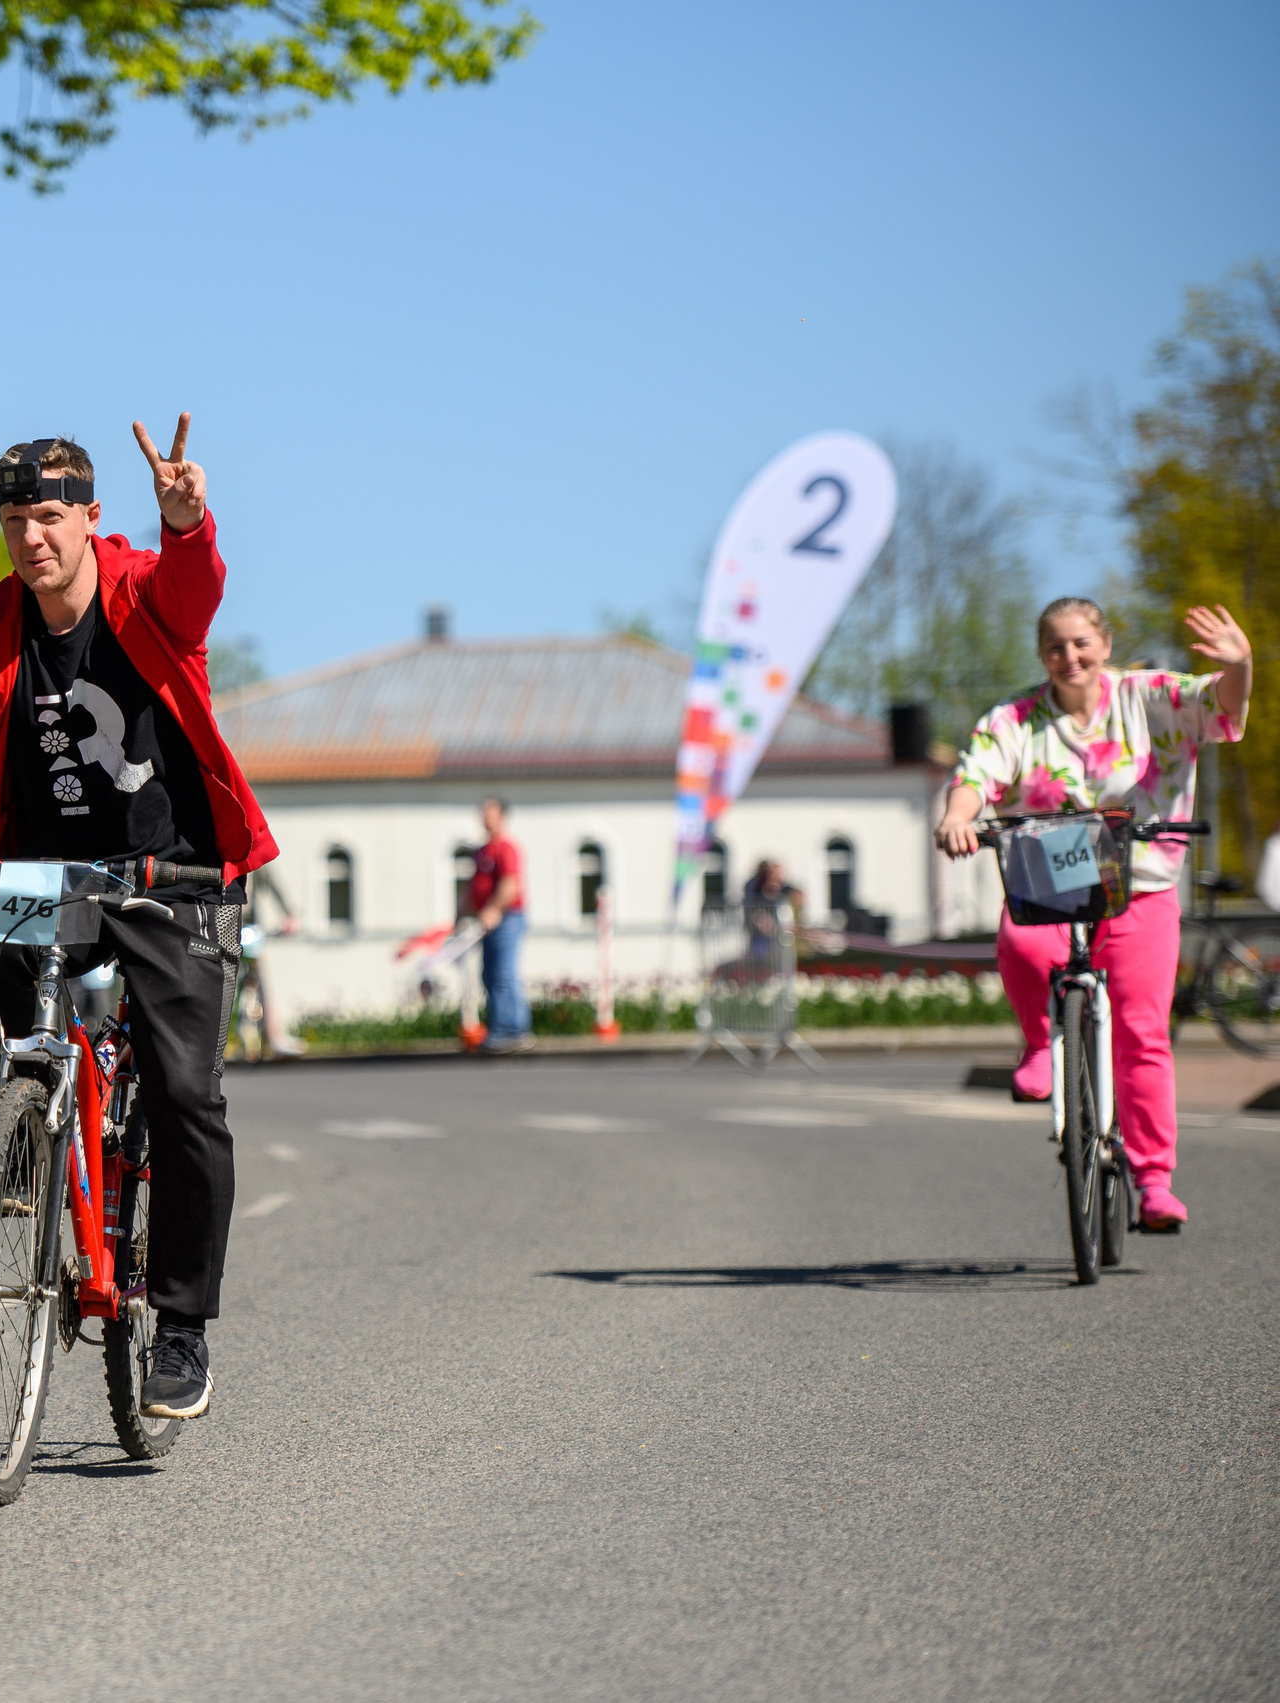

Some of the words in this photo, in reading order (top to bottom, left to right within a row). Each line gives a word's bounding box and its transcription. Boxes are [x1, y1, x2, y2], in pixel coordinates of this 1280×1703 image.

[790, 473, 850, 556] 2
[1052, 848, 1091, 872] 504
[1, 895, 54, 918] 476
